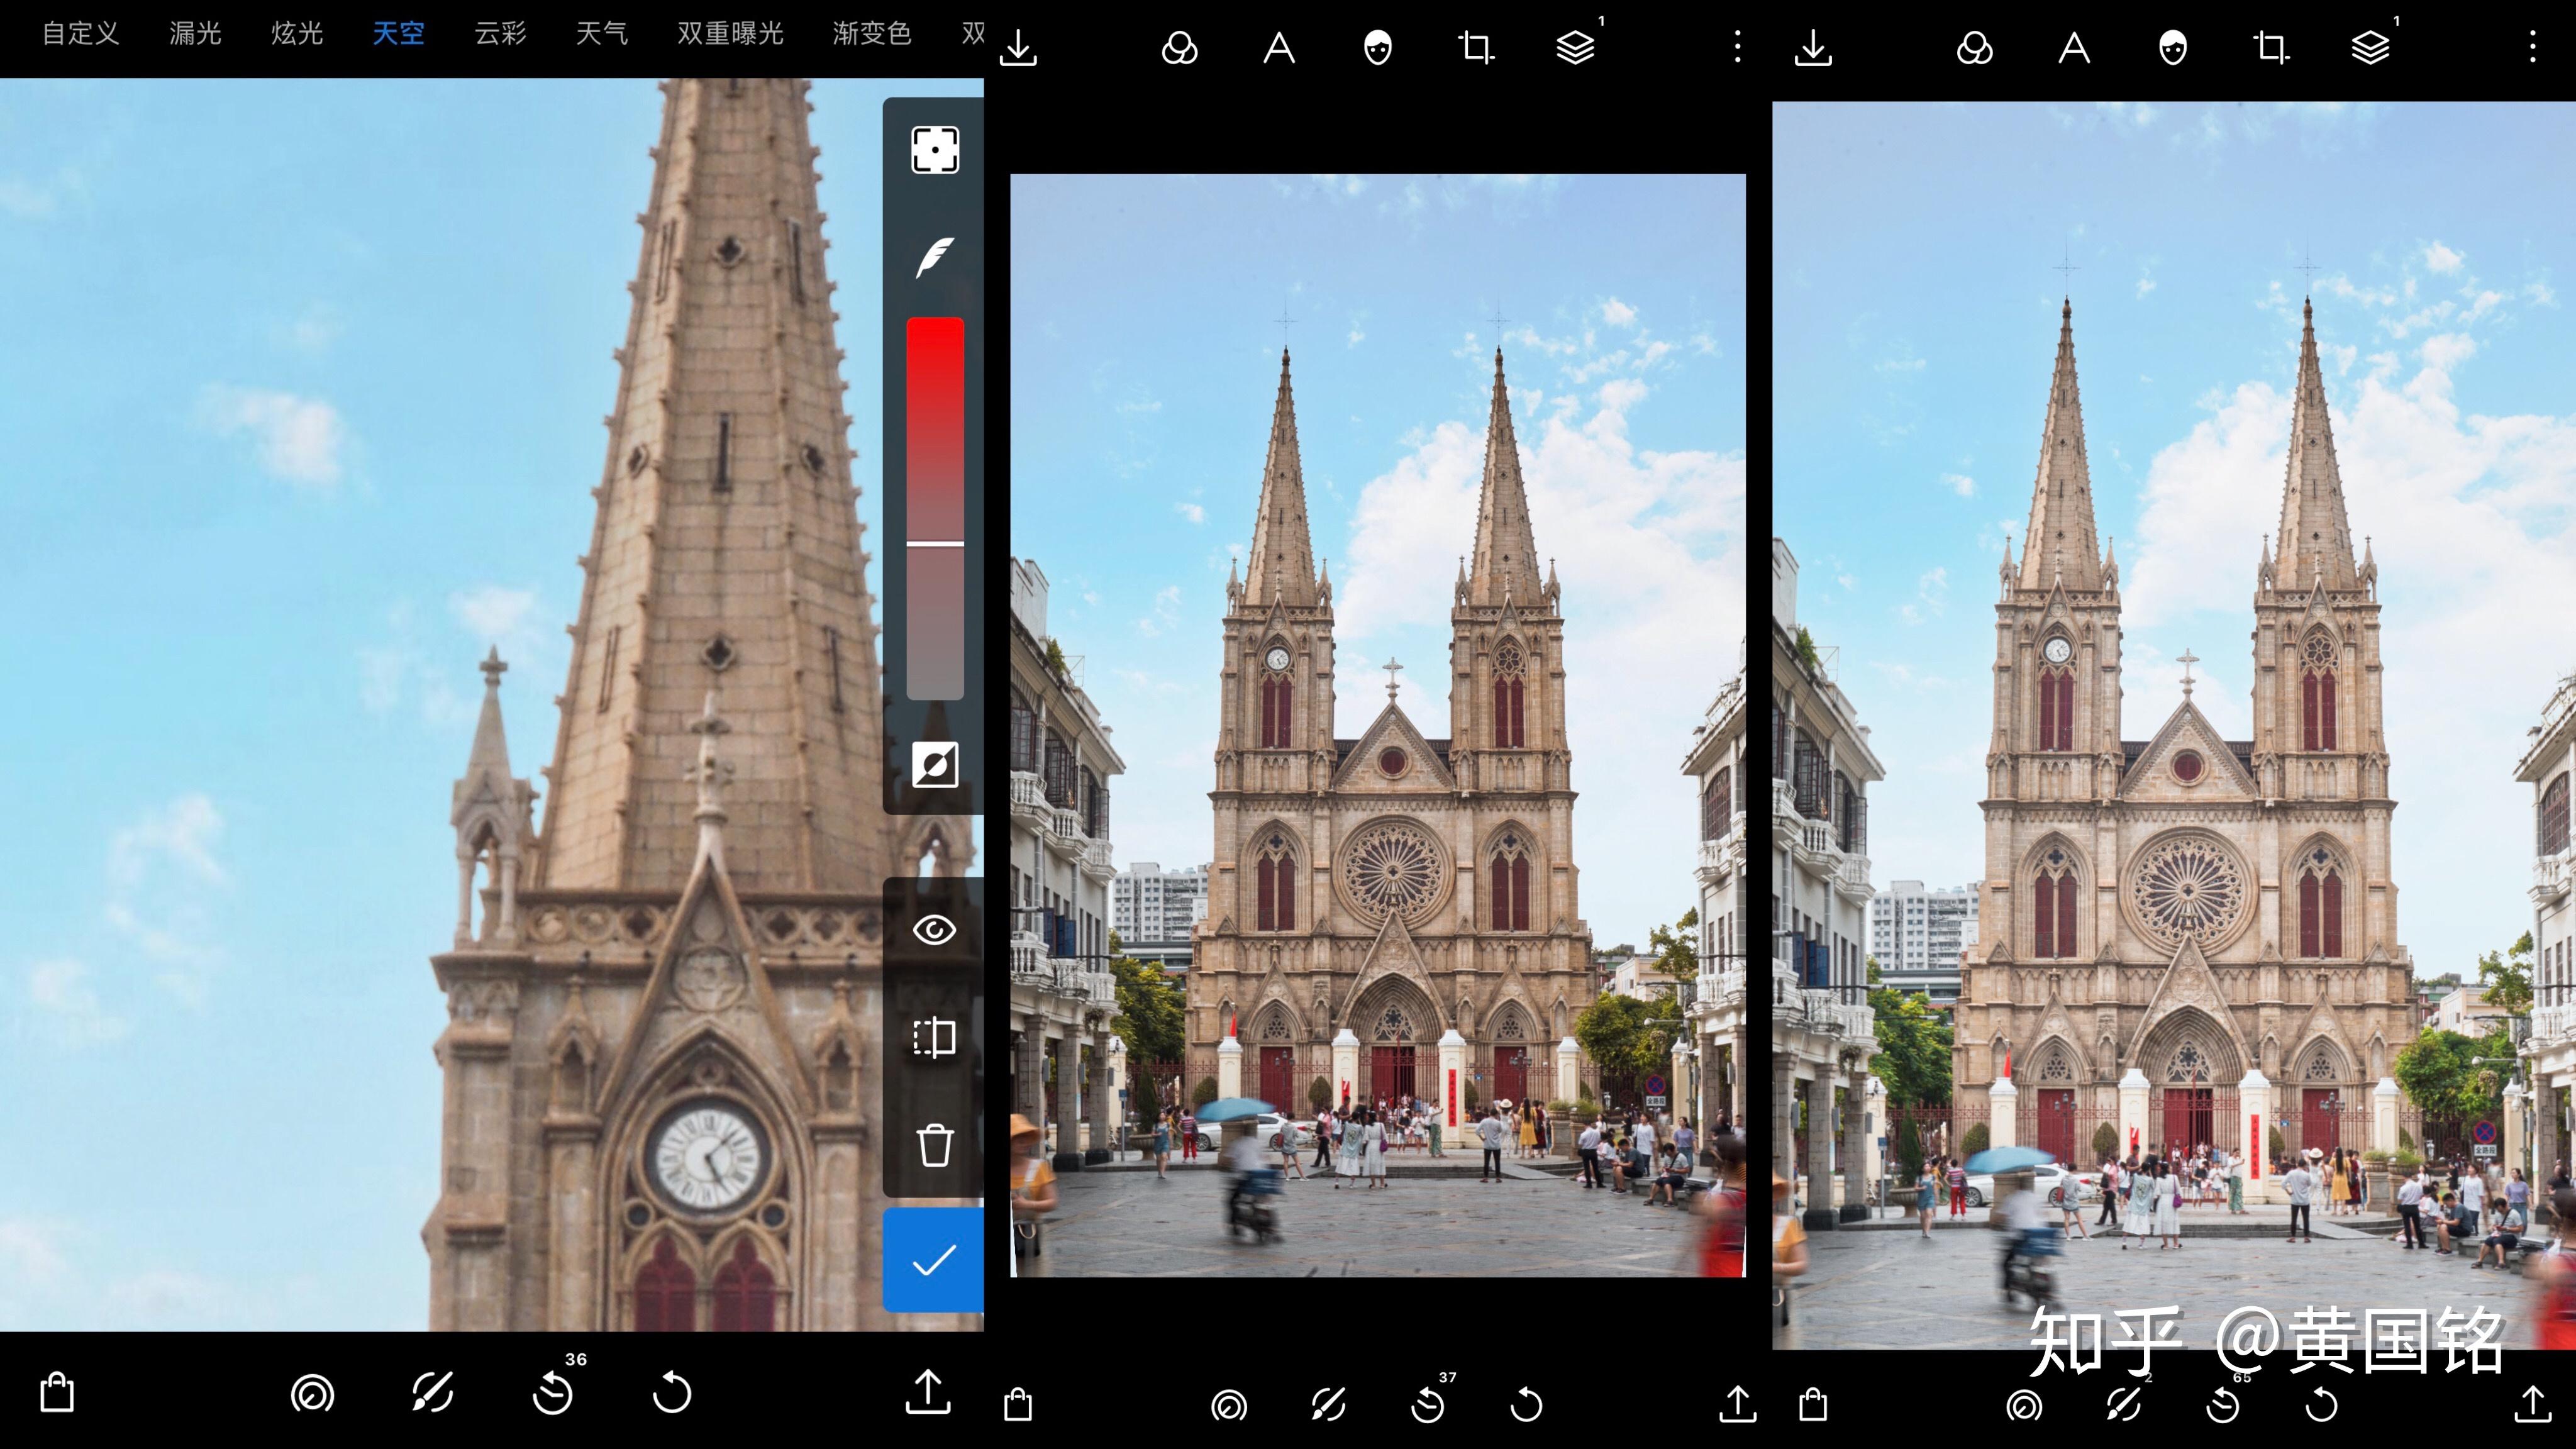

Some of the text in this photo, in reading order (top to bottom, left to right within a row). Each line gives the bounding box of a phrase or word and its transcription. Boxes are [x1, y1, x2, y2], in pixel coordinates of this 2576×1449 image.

[1598, 15, 1604, 26] 1
[2393, 15, 2399, 26] 1
[45, 20, 119, 45] 自定义
[170, 20, 221, 45] 漏光
[272, 20, 323, 45] 炫光
[374, 20, 424, 45] 天空
[475, 20, 526, 45] 云彩
[577, 20, 628, 45] 天气
[679, 20, 783, 45] 双重曝光
[834, 20, 911, 45] 渐变色
[2475, 1146, 2496, 1154] 全路段
[565, 1352, 587, 1367] 36
[1439, 1372, 1457, 1384] 37
[2233, 1372, 2251, 1383] 65
